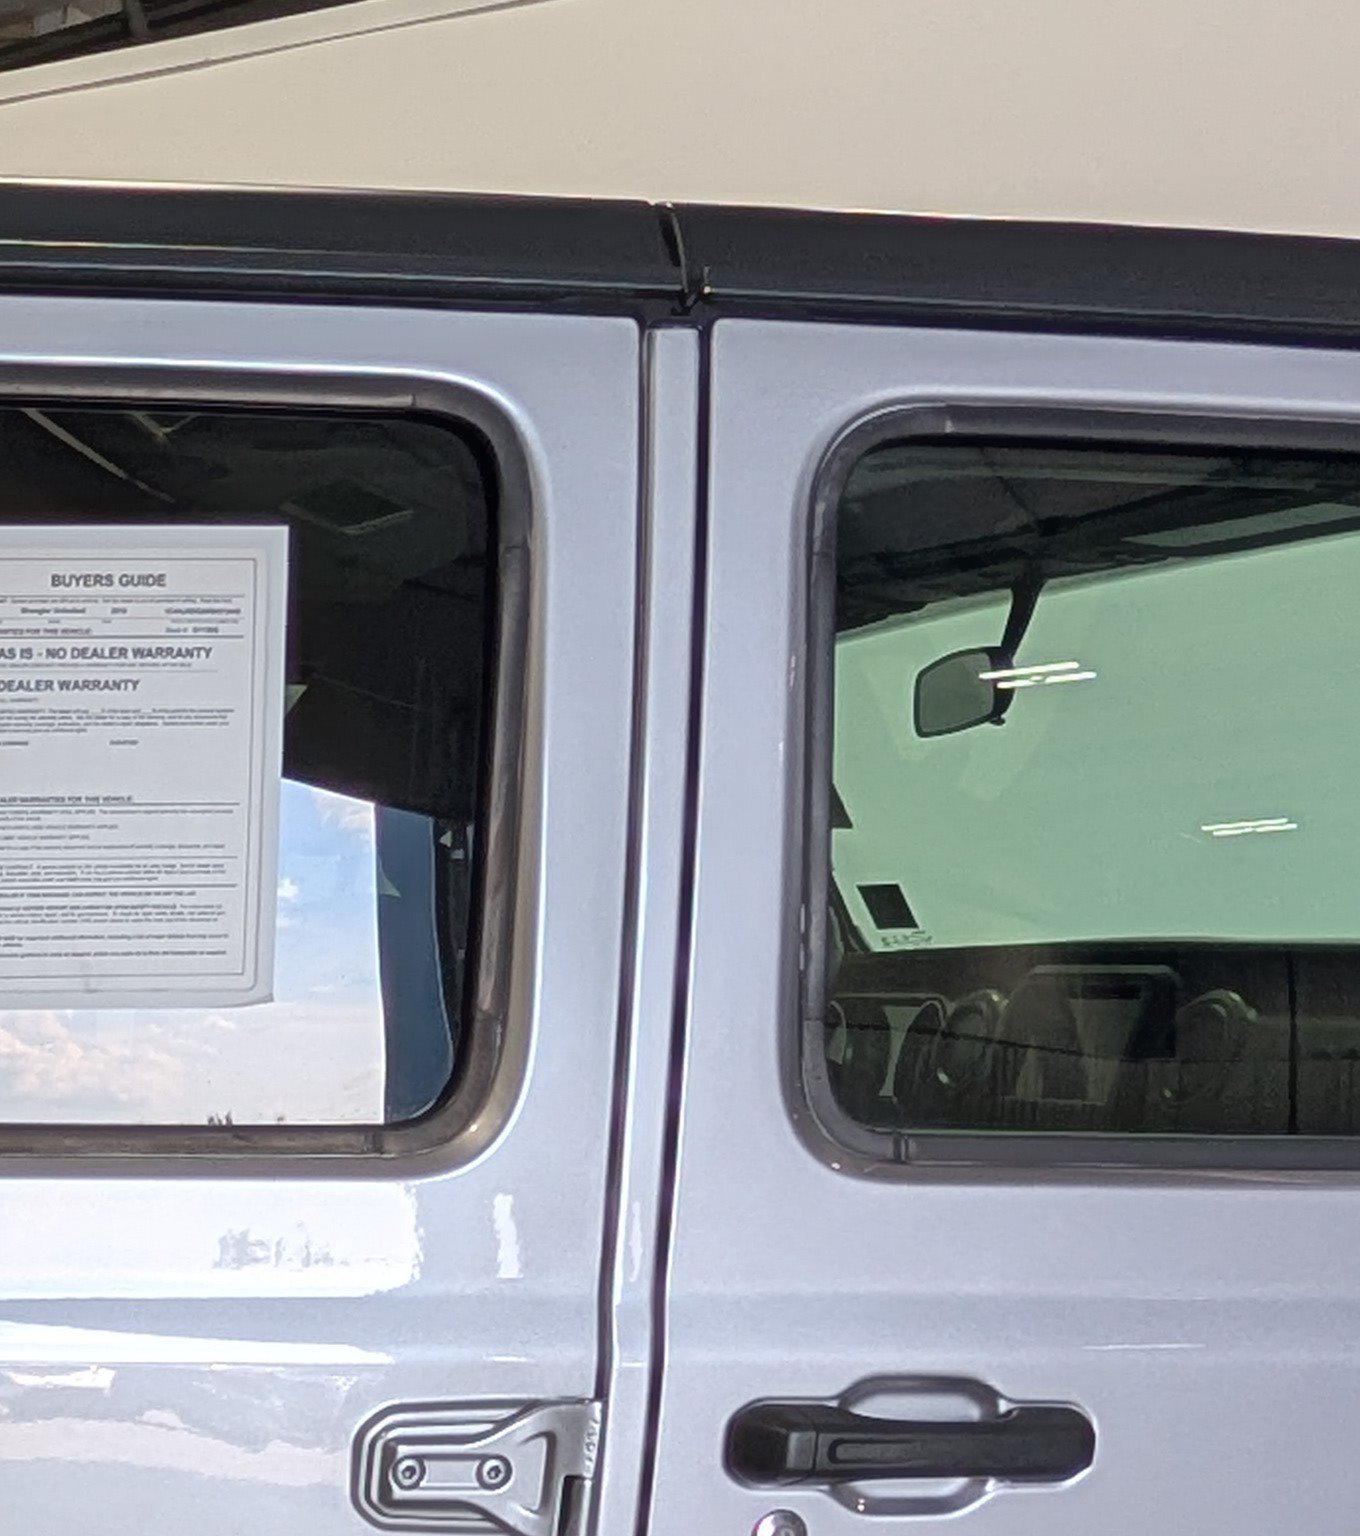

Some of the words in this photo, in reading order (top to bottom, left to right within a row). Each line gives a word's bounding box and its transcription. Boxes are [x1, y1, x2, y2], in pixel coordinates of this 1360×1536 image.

[50, 573, 114, 588] BUYERS
[118, 573, 167, 588] GUIDE
[19, 647, 33, 660] IS
[45, 647, 67, 660] NO
[70, 646, 129, 660] DEALER
[131, 646, 213, 660] WARRANTY
[57, 679, 141, 692] WARRANTY
